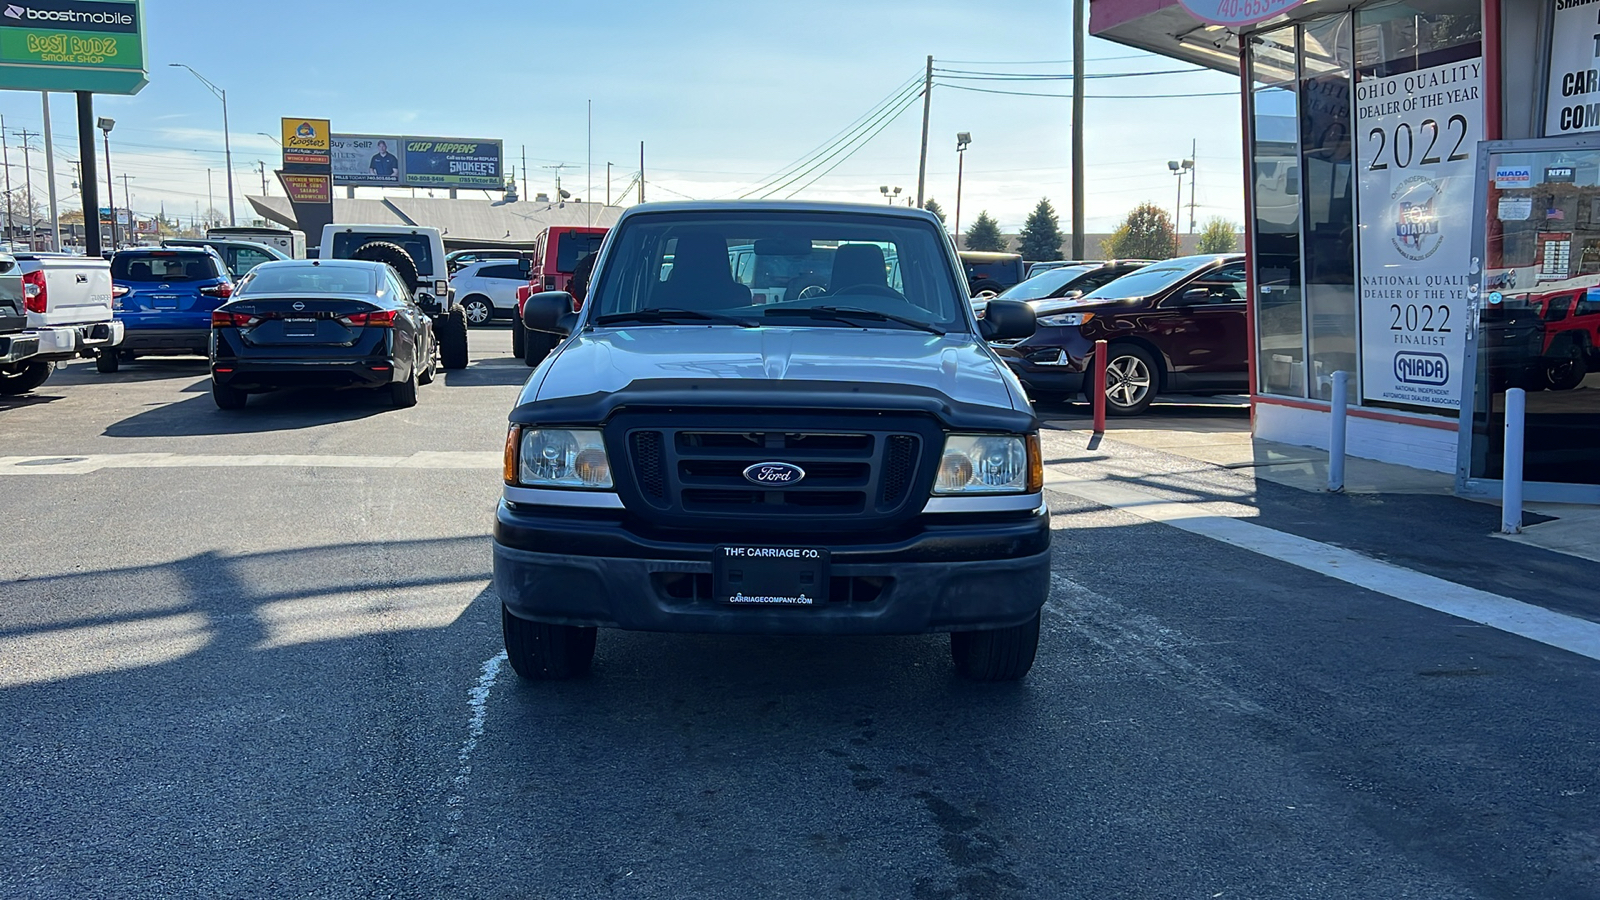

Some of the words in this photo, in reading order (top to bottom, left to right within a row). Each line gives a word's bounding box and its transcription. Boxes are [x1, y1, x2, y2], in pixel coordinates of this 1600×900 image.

[27, 8, 132, 24] boostmobile
[70, 36, 117, 56] BUDZ
[42, 54, 76, 62] SMOKE
[78, 55, 104, 63] SHOP
[1358, 80, 1396, 100] OHIO
[1404, 62, 1480, 94] QUALITY
[1562, 69, 1600, 97] CAR
[1360, 101, 1400, 119] DEALER
[1403, 98, 1417, 112] OF
[1420, 93, 1443, 108] THE
[1447, 86, 1478, 103] YEAR
[288, 136, 324, 147] Roosters
[354, 140, 372, 148] Sell?
[1369, 114, 1469, 171] 2022
[407, 142, 432, 152] CHIP
[434, 143, 477, 154] HAPPENS
[450, 161, 494, 174] SNOKEE'S
[1400, 222, 1431, 235] OIADA
[1363, 276, 1420, 286] NATIONAL
[1364, 290, 1402, 298] DEALER
[1407, 290, 1420, 299] OF
[1424, 290, 1445, 299] THE
[1390, 304, 1451, 332] 2022
[1394, 334, 1446, 346] FINALIST
[1398, 358, 1443, 379] NIADA
[1383, 392, 1410, 400] AUTOMOBILE
[1418, 387, 1450, 395] INDEPENDENT
[757, 466, 792, 481] Ford
[724, 547, 744, 556] THE
[747, 548, 800, 558] CARRIAGE
[802, 550, 820, 558] CO.
[730, 596, 812, 604] CARRIAGECOMPANY.COM
